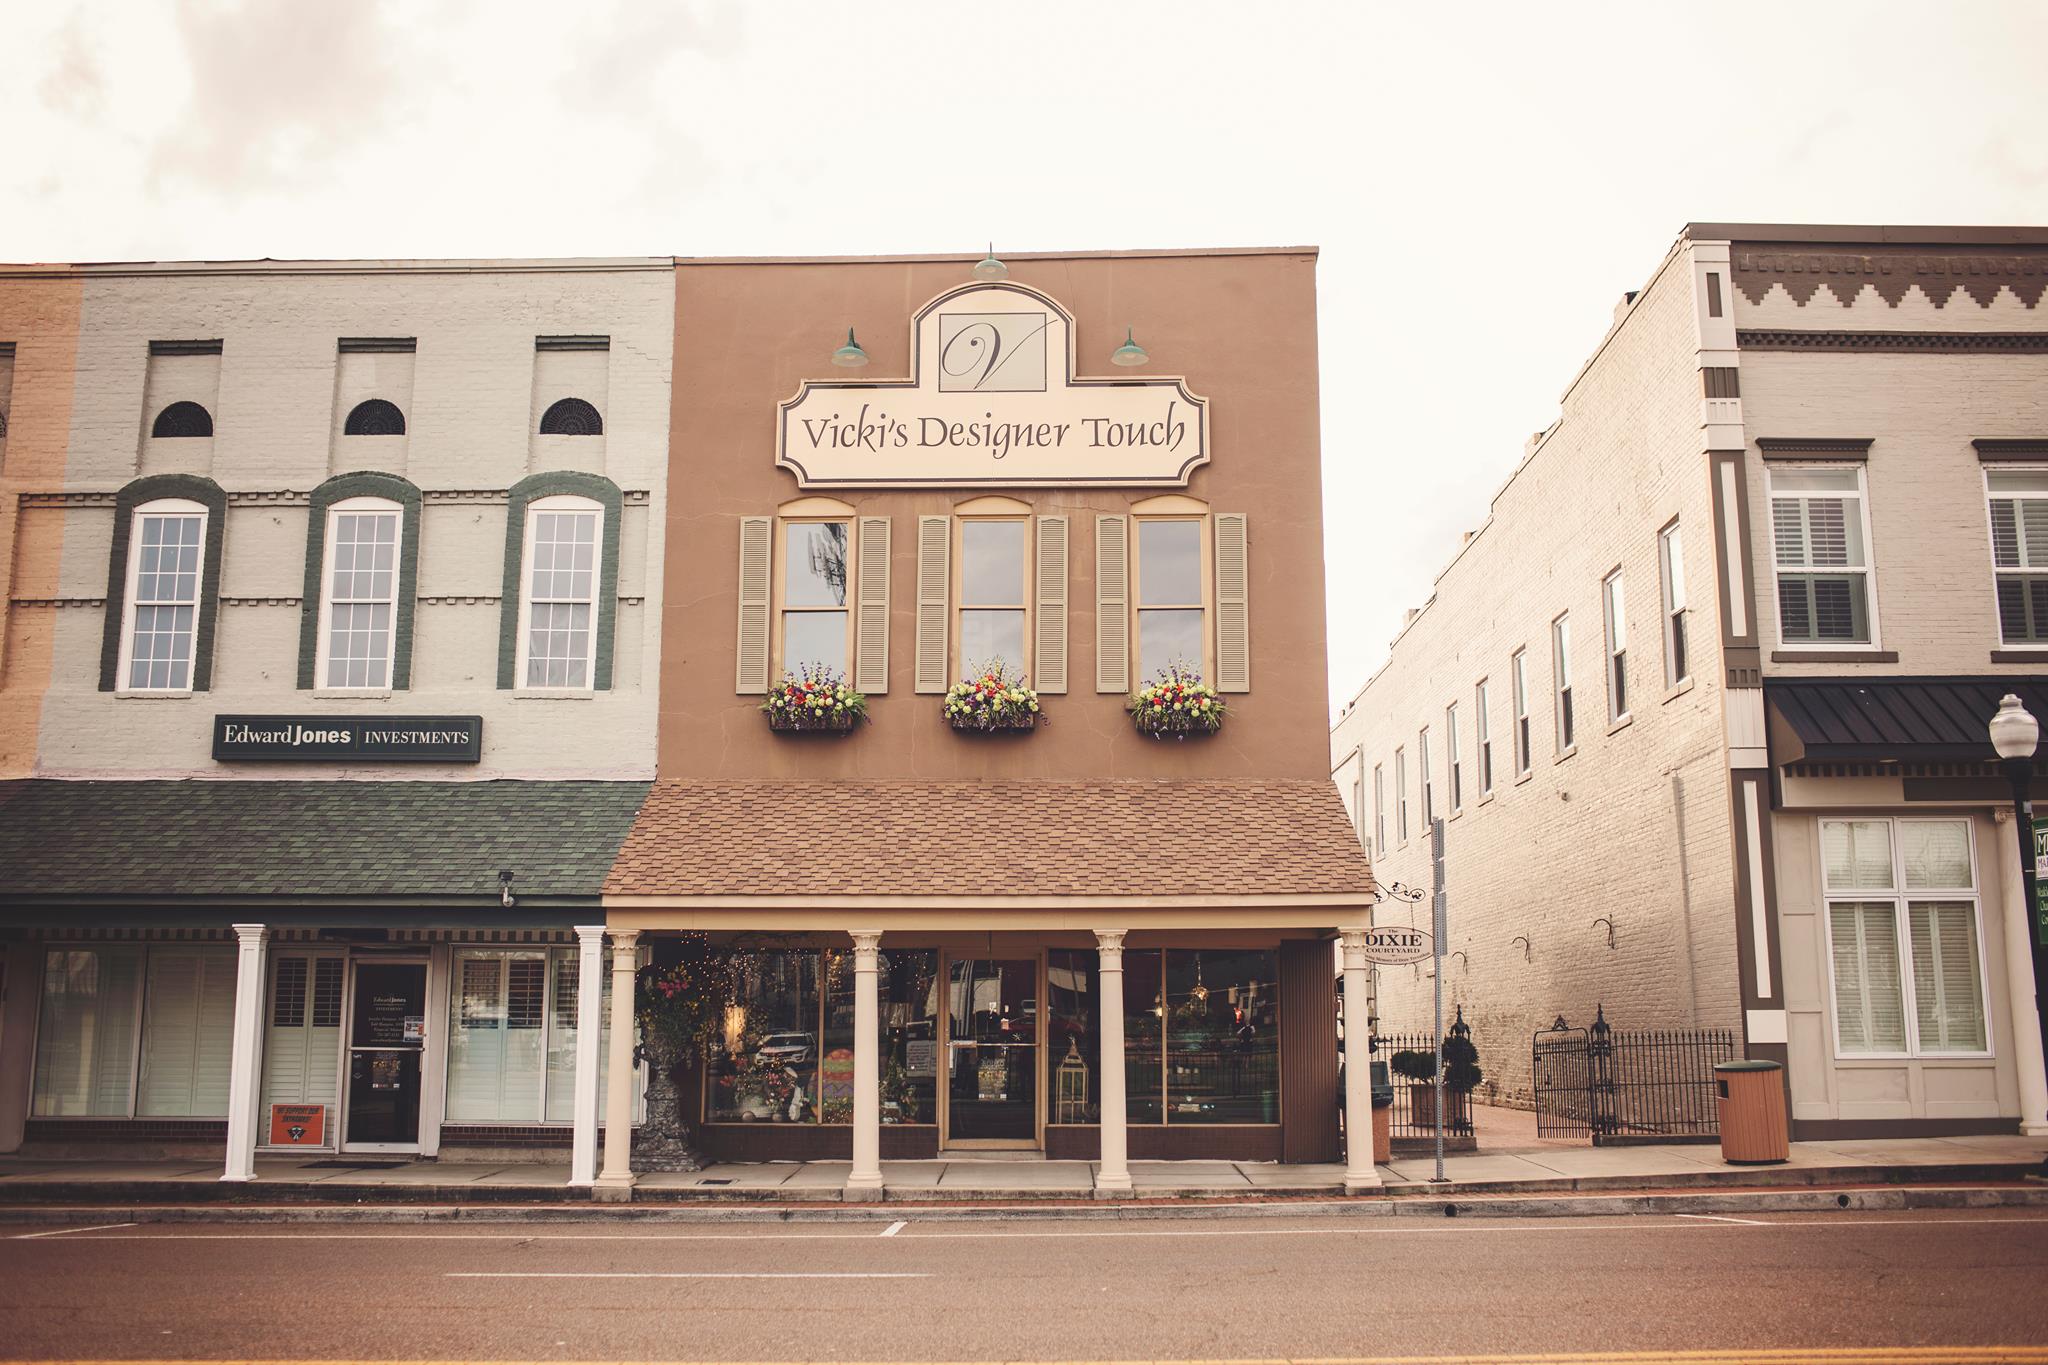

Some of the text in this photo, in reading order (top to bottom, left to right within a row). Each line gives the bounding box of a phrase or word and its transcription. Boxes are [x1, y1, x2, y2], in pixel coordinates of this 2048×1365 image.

[801, 401, 1185, 459] Vicki's Designer Touch
[365, 731, 469, 744] INVESTMENTS
[1366, 934, 1422, 947] DIXIE
